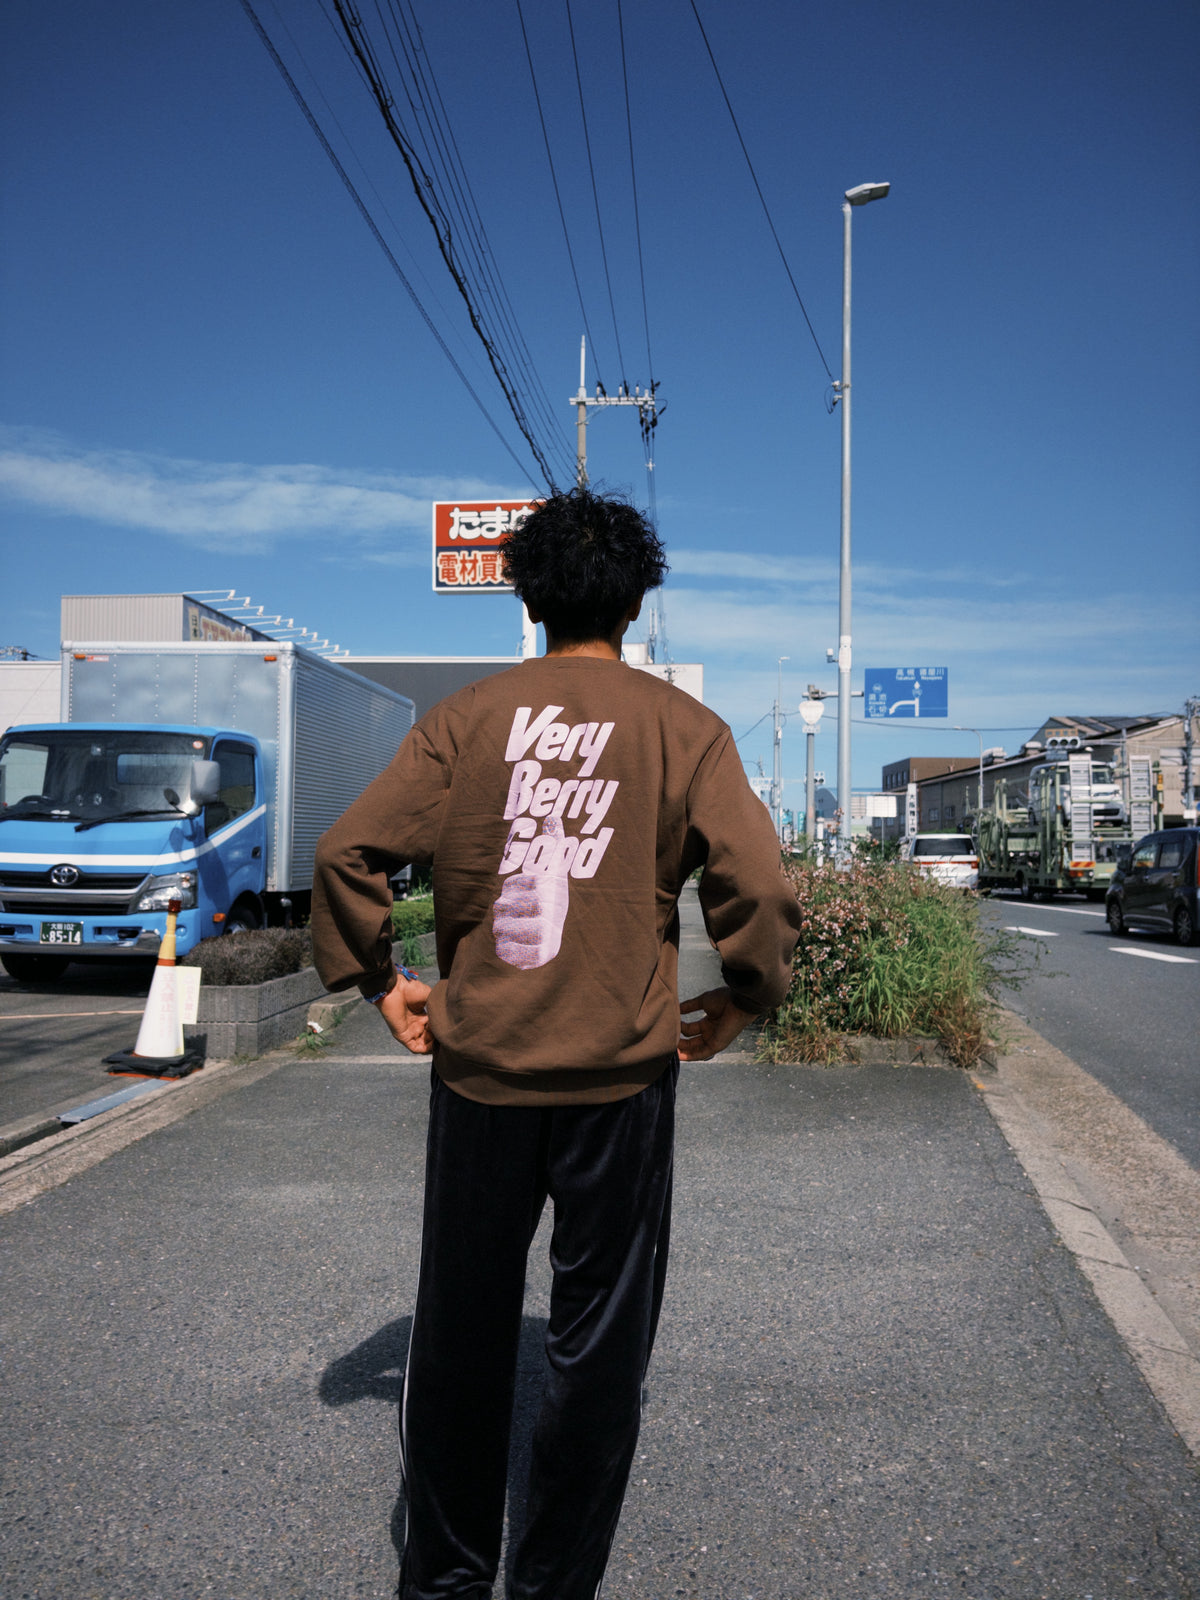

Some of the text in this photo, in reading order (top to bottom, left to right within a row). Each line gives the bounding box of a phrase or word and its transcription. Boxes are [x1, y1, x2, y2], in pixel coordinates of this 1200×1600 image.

[504, 705, 616, 777] Very
[503, 759, 620, 834] Berry
[498, 817, 615, 879] Good
[49, 931, 81, 943] 85-14
